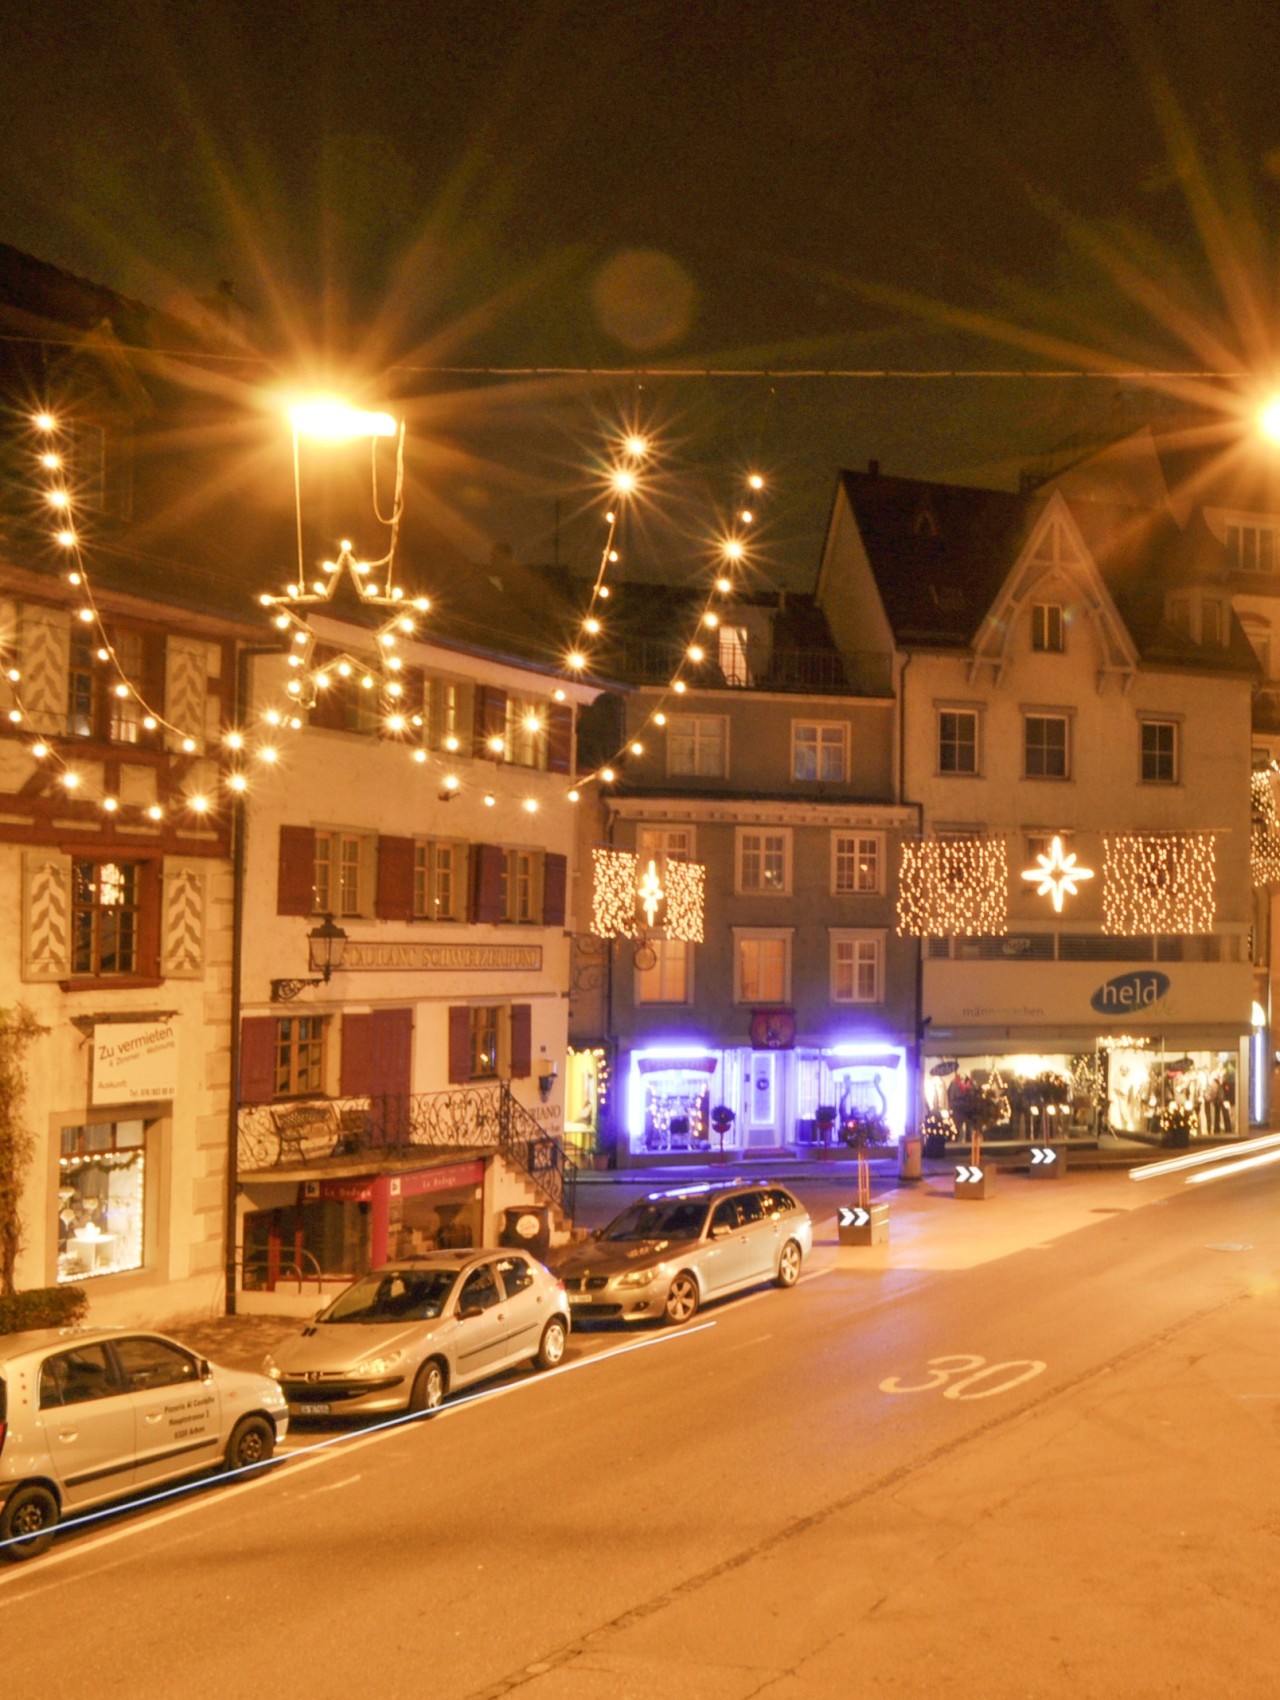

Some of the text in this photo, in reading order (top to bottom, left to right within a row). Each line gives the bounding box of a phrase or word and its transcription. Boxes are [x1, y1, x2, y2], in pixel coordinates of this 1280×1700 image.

[1103, 979, 1158, 1005] held
[98, 1026, 174, 1060] Zu vermieten
[878, 1354, 1047, 1400] 30
